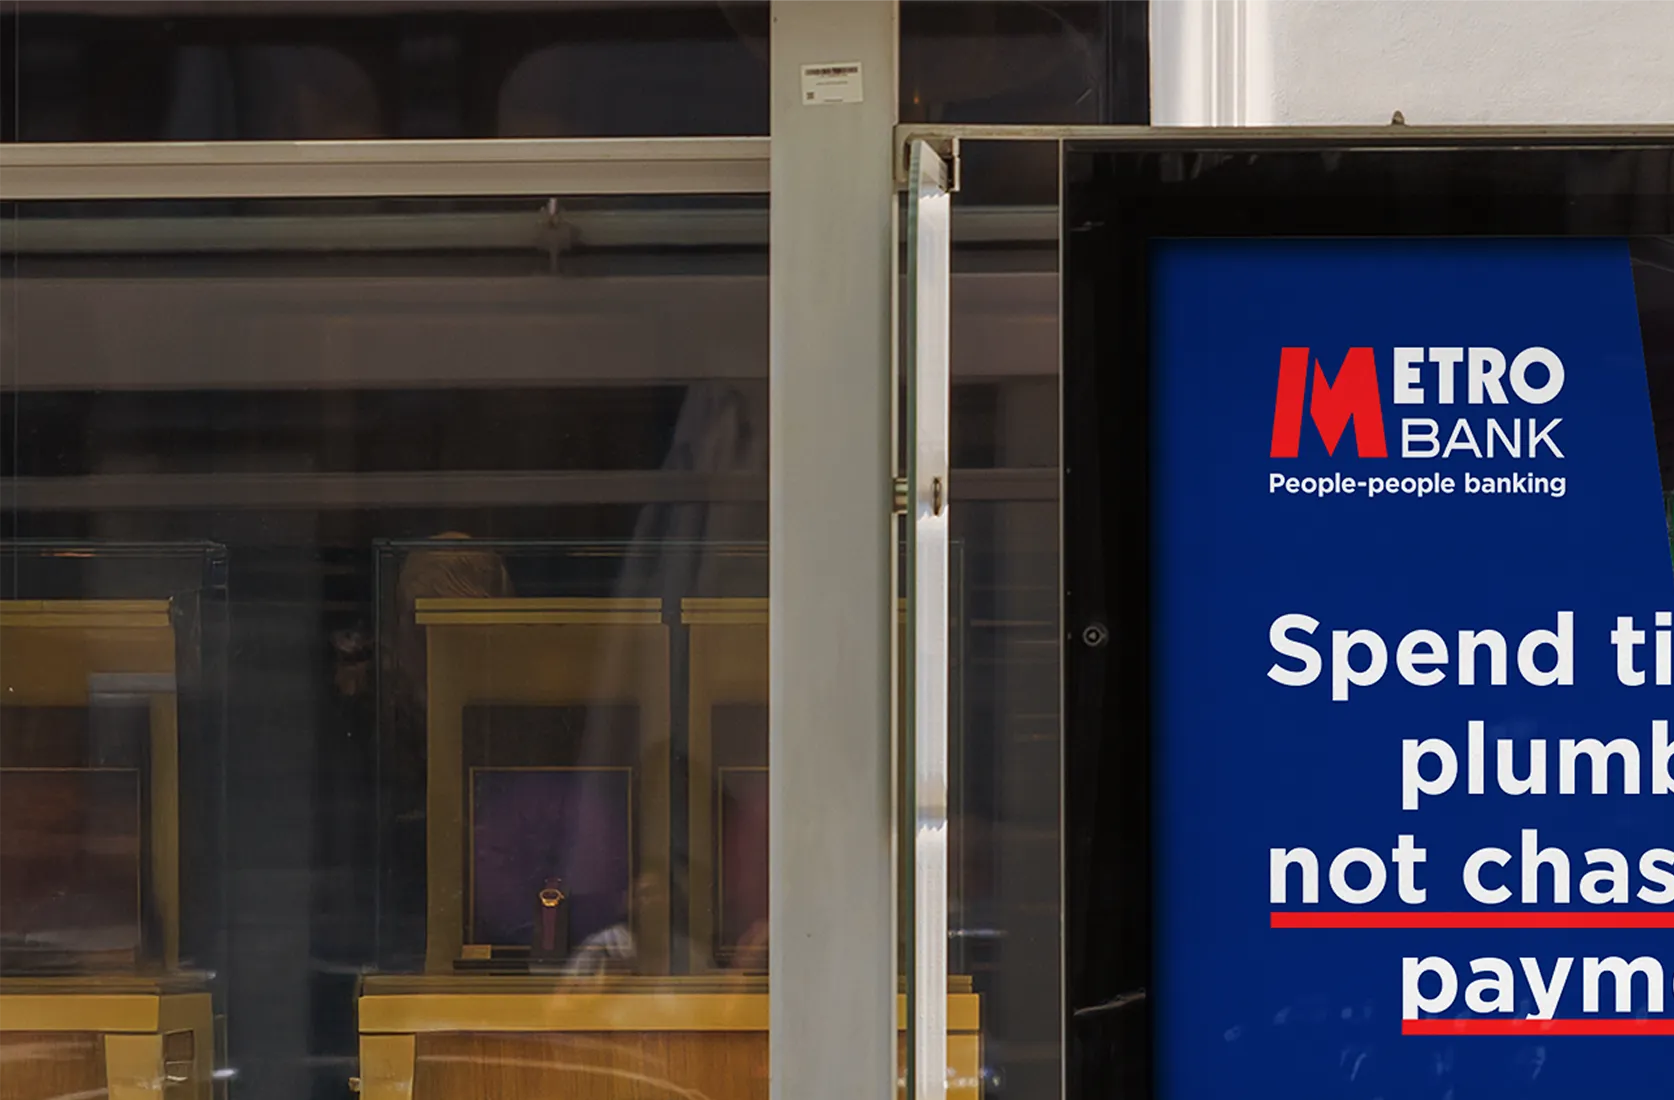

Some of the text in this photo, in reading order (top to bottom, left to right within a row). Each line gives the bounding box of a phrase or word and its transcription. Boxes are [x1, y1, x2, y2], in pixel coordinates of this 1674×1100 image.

[1270, 346, 1566, 459] METRO
[1401, 418, 1565, 459] BANK
[1270, 473, 1565, 497] People-people banking
[1268, 612, 1573, 700] Spend
[1271, 835, 1426, 903] not
